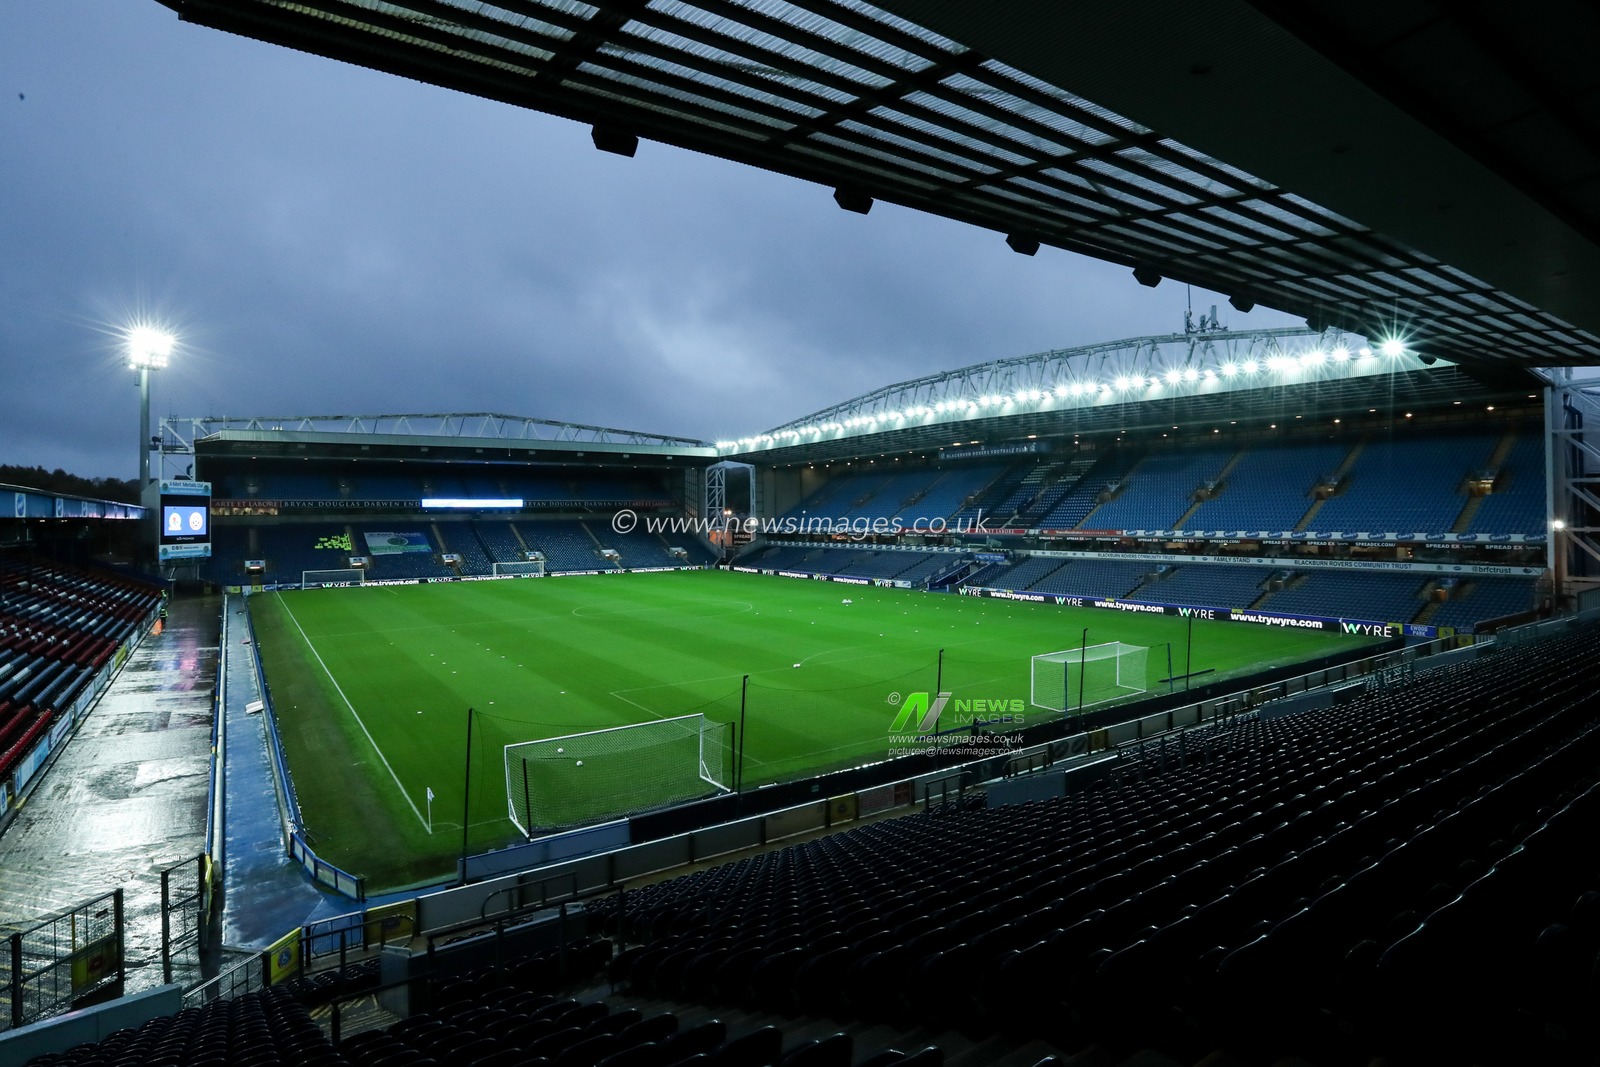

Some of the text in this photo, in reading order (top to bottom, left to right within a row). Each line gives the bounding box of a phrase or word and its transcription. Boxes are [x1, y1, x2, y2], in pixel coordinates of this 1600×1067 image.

[1353, 561, 1390, 569] COMMUNITY
[1472, 566, 1512, 574] @brfctrust
[958, 587, 982, 598] WYRE
[990, 591, 1045, 602] www.trywyre.com
[1055, 596, 1083, 607] WYRE
[1094, 600, 1164, 613] www.trywyre.com
[1178, 607, 1215, 620] WYRE
[1230, 612, 1323, 629] www.trywyre.com
[1342, 622, 1392, 638] WYRE
